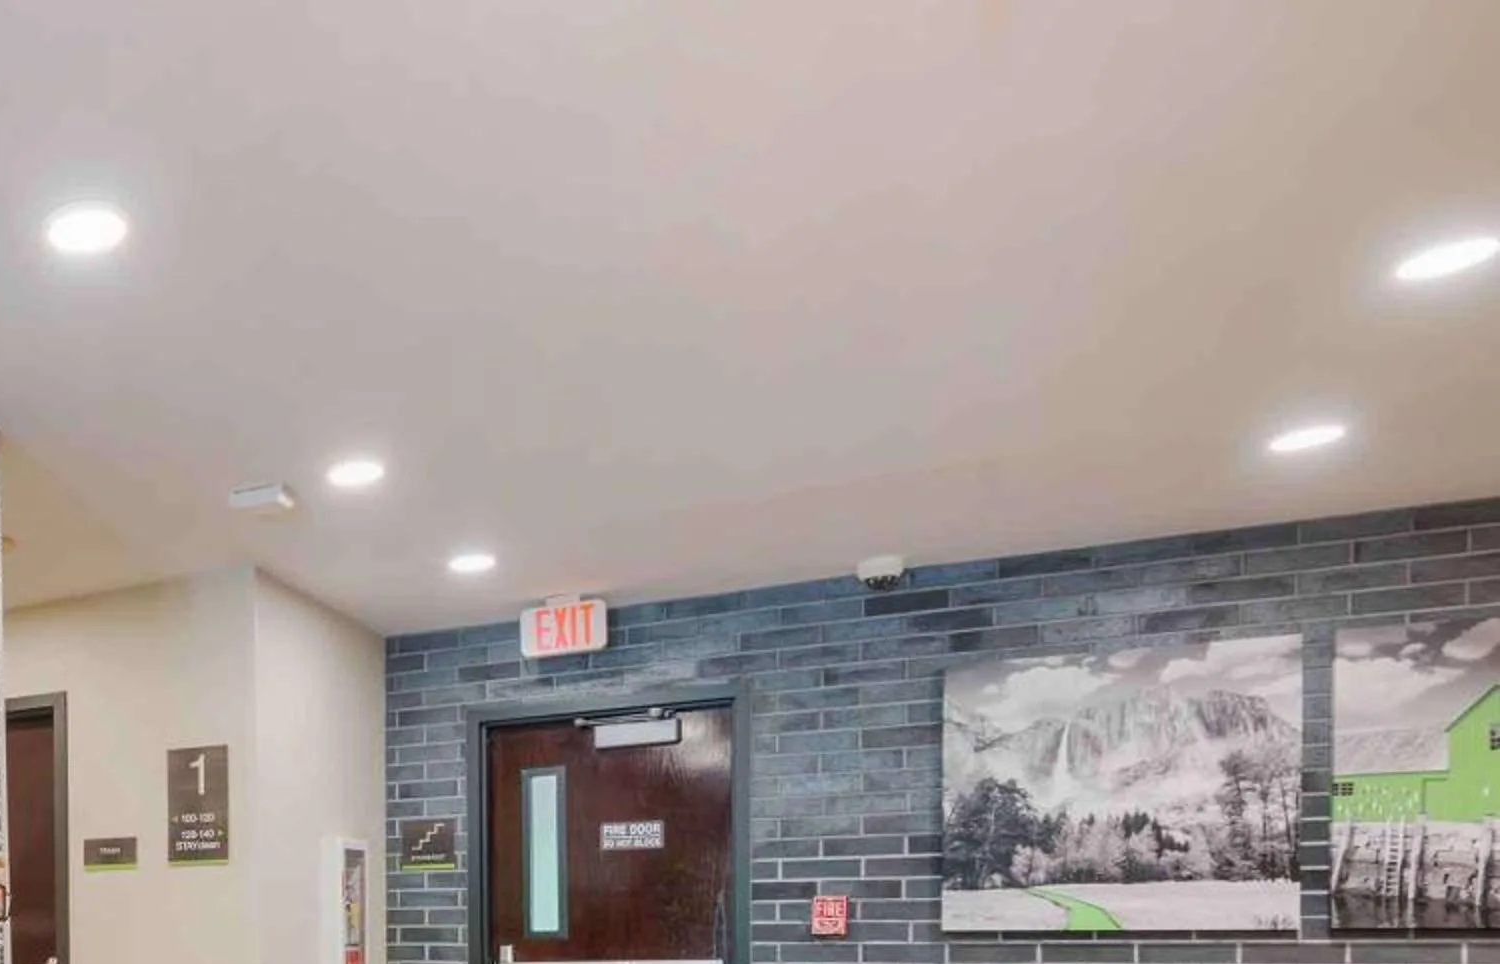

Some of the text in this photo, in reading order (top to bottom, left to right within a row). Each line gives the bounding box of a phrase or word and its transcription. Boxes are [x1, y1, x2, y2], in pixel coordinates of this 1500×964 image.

[534, 602, 595, 650] EXIT
[188, 753, 206, 796] 1
[603, 821, 661, 836] FIRE DOOR
[633, 836, 661, 848] BLOCK
[815, 901, 845, 917] FIRE
